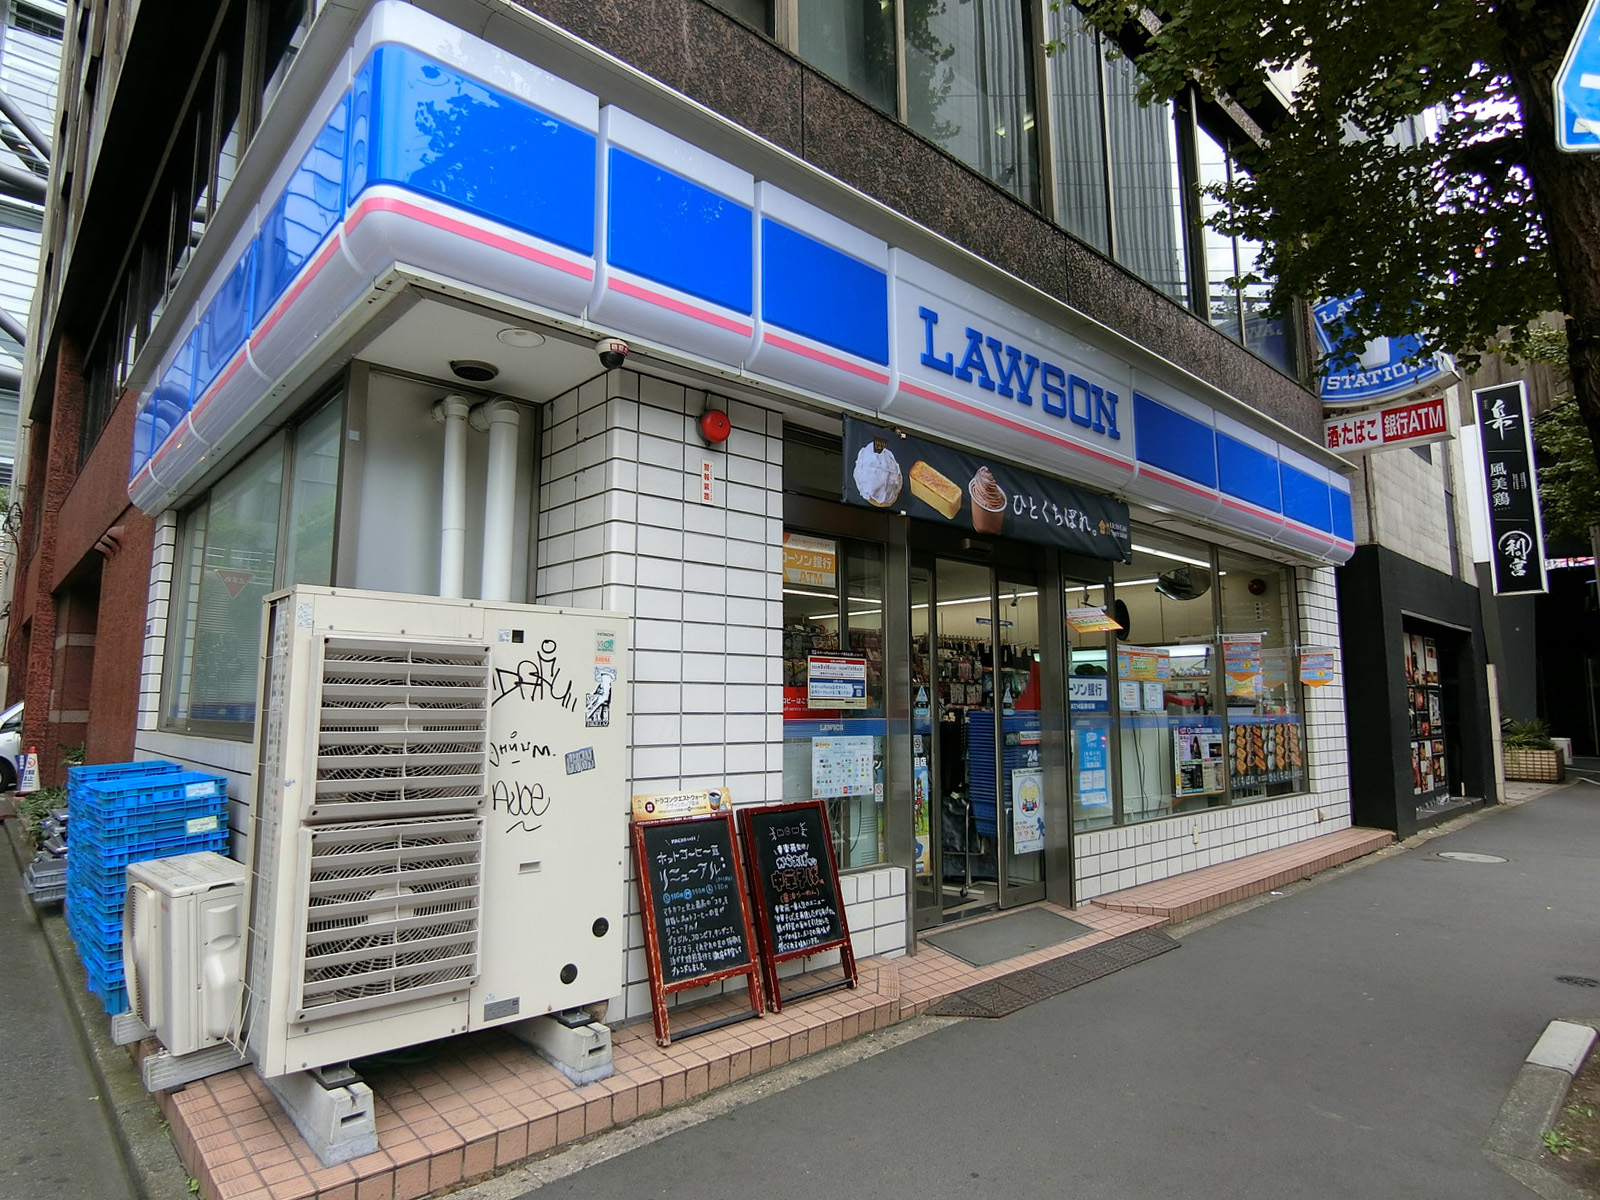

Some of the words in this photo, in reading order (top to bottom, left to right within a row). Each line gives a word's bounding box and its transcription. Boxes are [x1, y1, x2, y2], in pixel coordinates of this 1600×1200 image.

[919, 306, 1120, 440] LAWSON
[1384, 405, 1443, 437] 銀行ATM
[1327, 419, 1378, 448] 酒・たばこ
[798, 571, 824, 585] ATM
[1027, 749, 1038, 762] 24
[655, 794, 707, 804] ドラゴンクエストウォーク
[657, 844, 720, 865] ホットコーヒー豆
